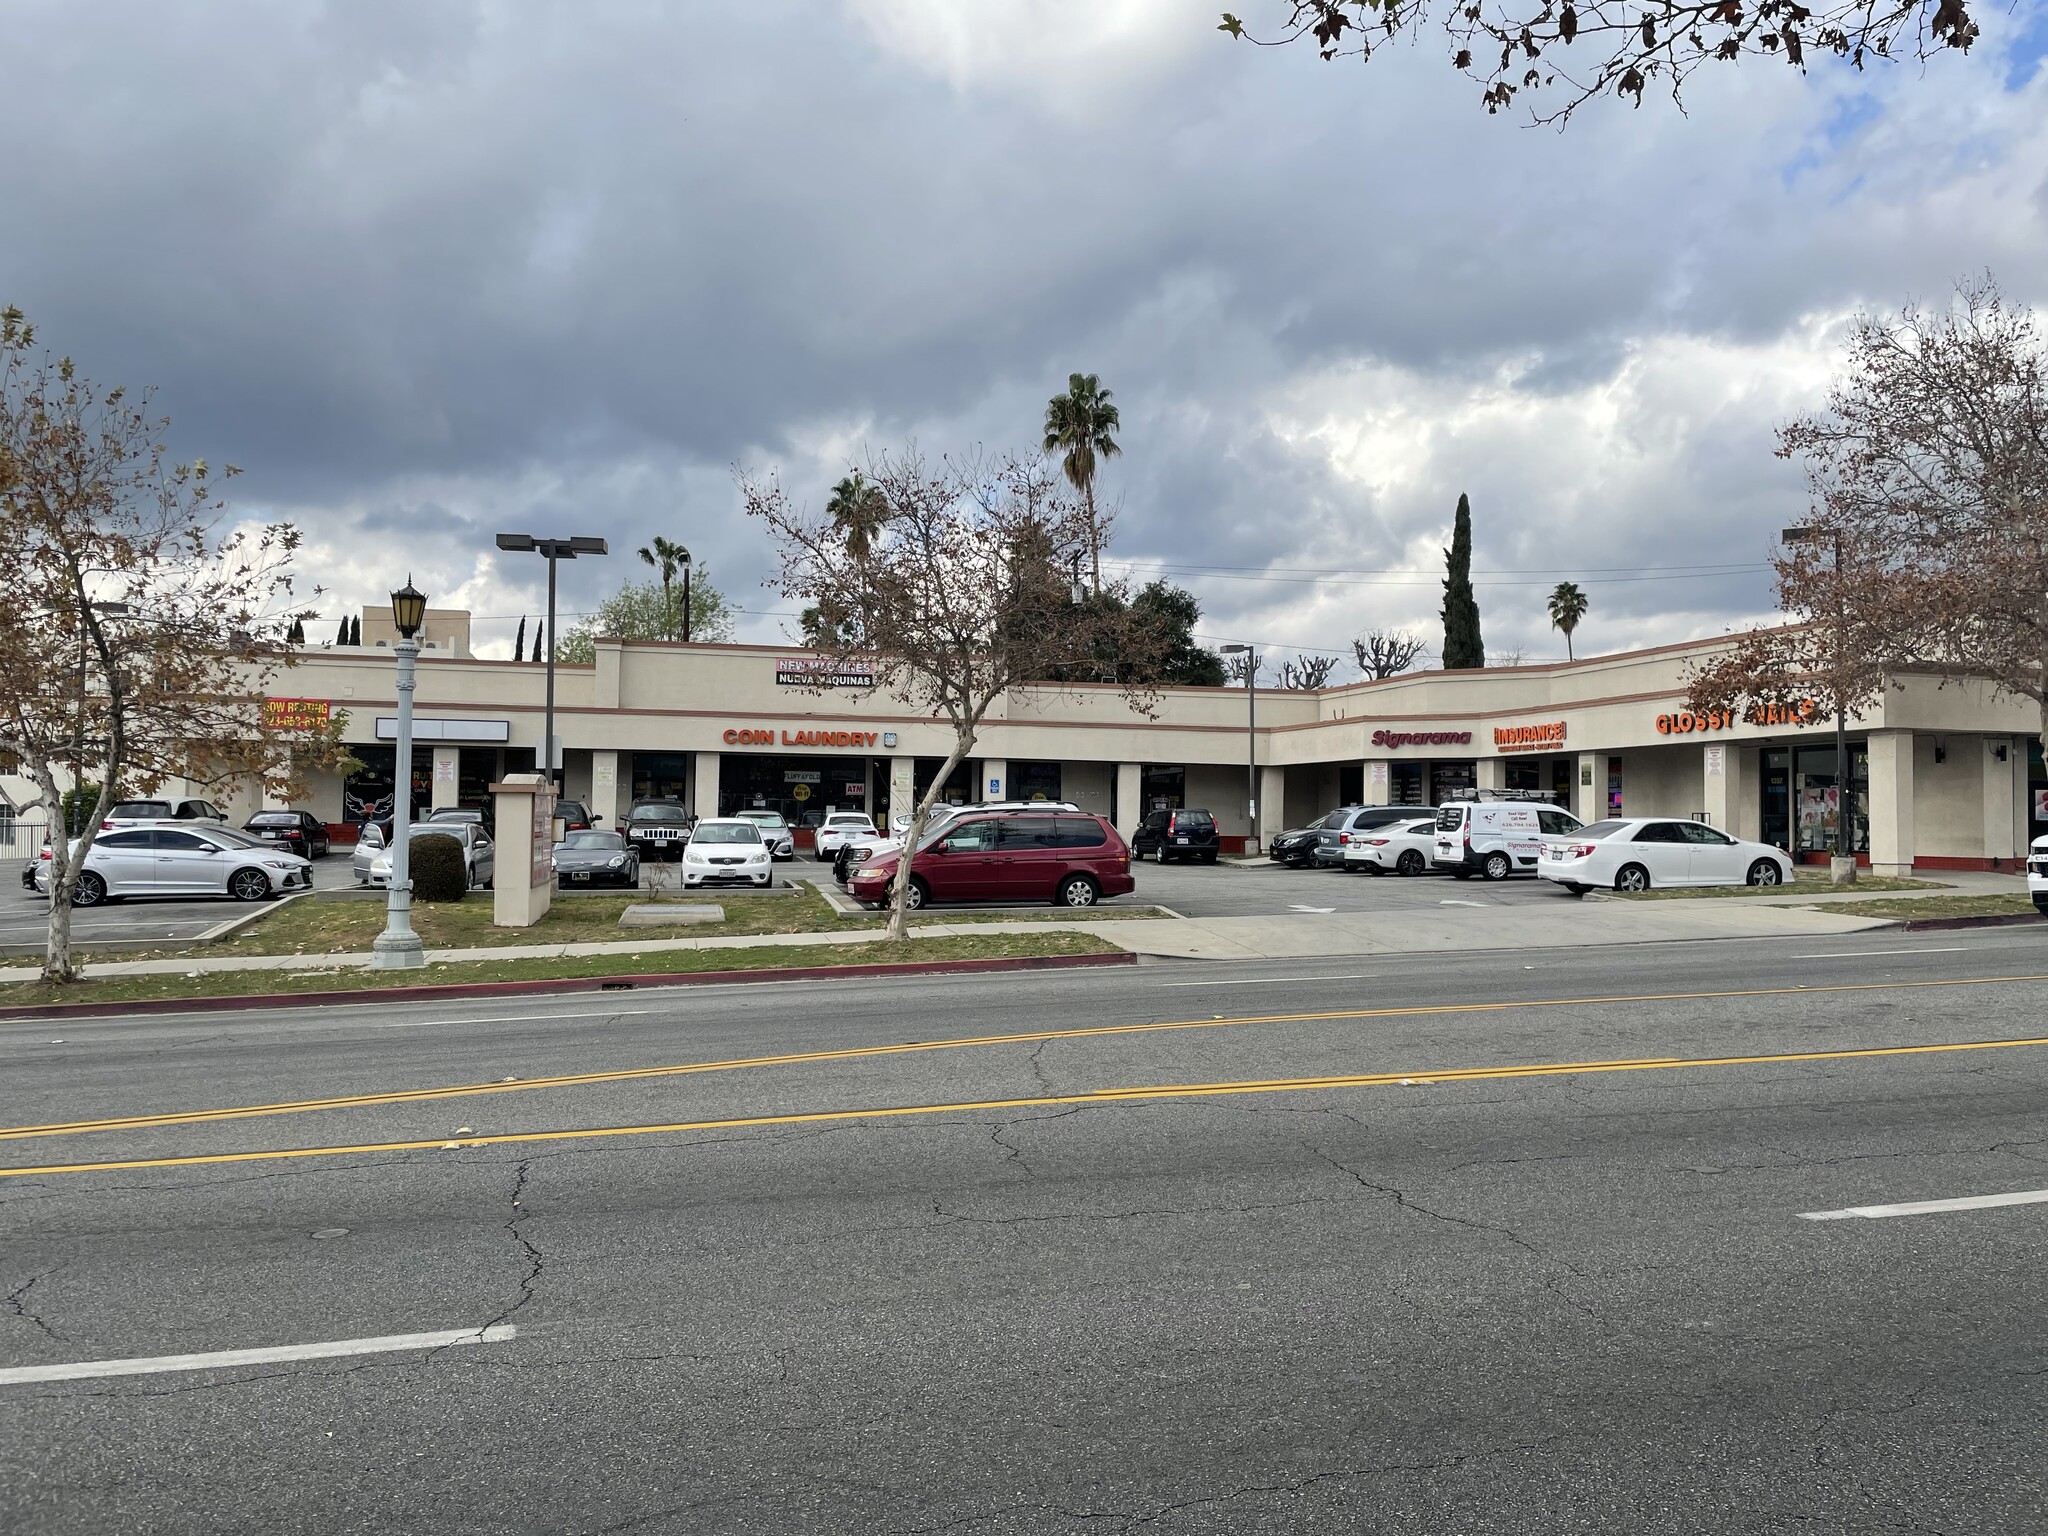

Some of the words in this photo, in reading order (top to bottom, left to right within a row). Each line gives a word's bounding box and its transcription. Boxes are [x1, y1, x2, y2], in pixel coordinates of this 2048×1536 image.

[1655, 709, 1734, 735] GLOSSY
[723, 729, 775, 745] COIN
[782, 730, 879, 747] LAUNDRY
[1371, 729, 1472, 749] Signarama
[1498, 723, 1562, 745] INSURANCE
[847, 784, 863, 794] ATM
